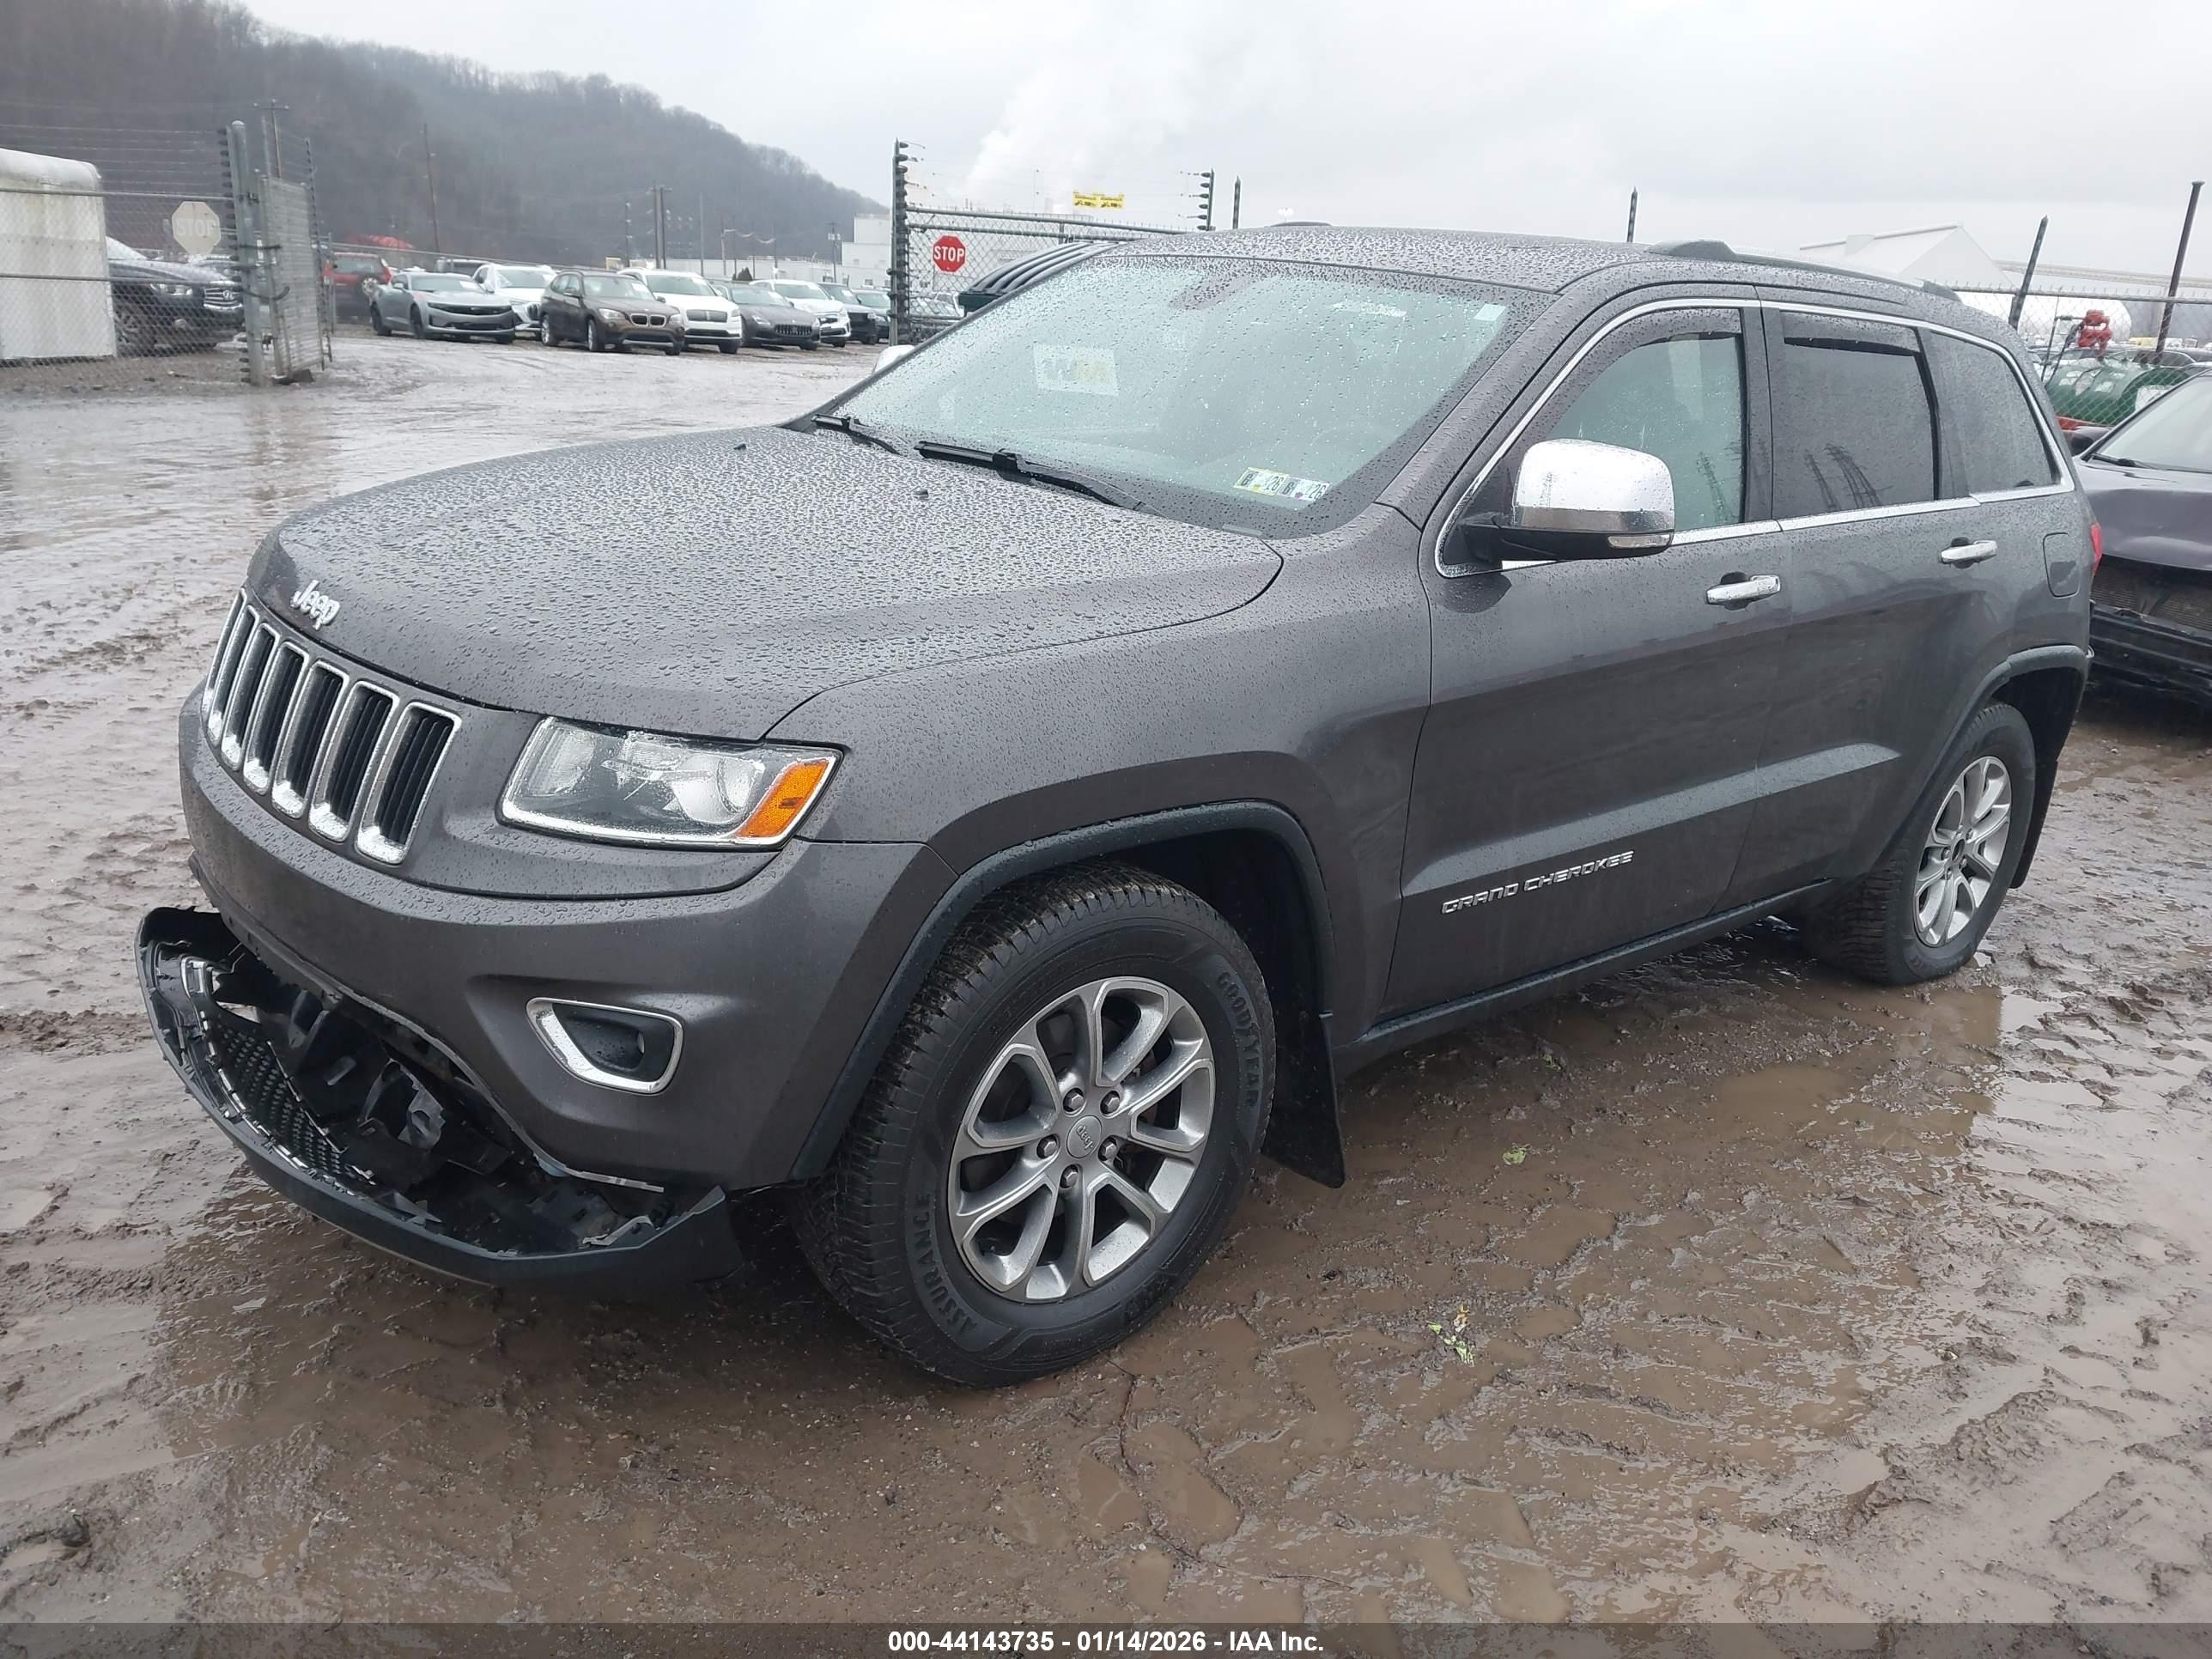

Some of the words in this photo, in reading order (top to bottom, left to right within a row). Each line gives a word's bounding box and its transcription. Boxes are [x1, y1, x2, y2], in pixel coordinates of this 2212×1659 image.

[176, 219, 217, 236] STOP
[933, 246, 965, 263] STOP
[289, 579, 341, 631] Jeep
[1440, 882, 1520, 915] GRAND
[1523, 850, 1635, 892] CHEROKEE
[1216, 971, 1260, 1109] GOODYEAR
[1076, 1125, 1094, 1151] Jeep
[914, 1193, 977, 1334] ASSURANCE
